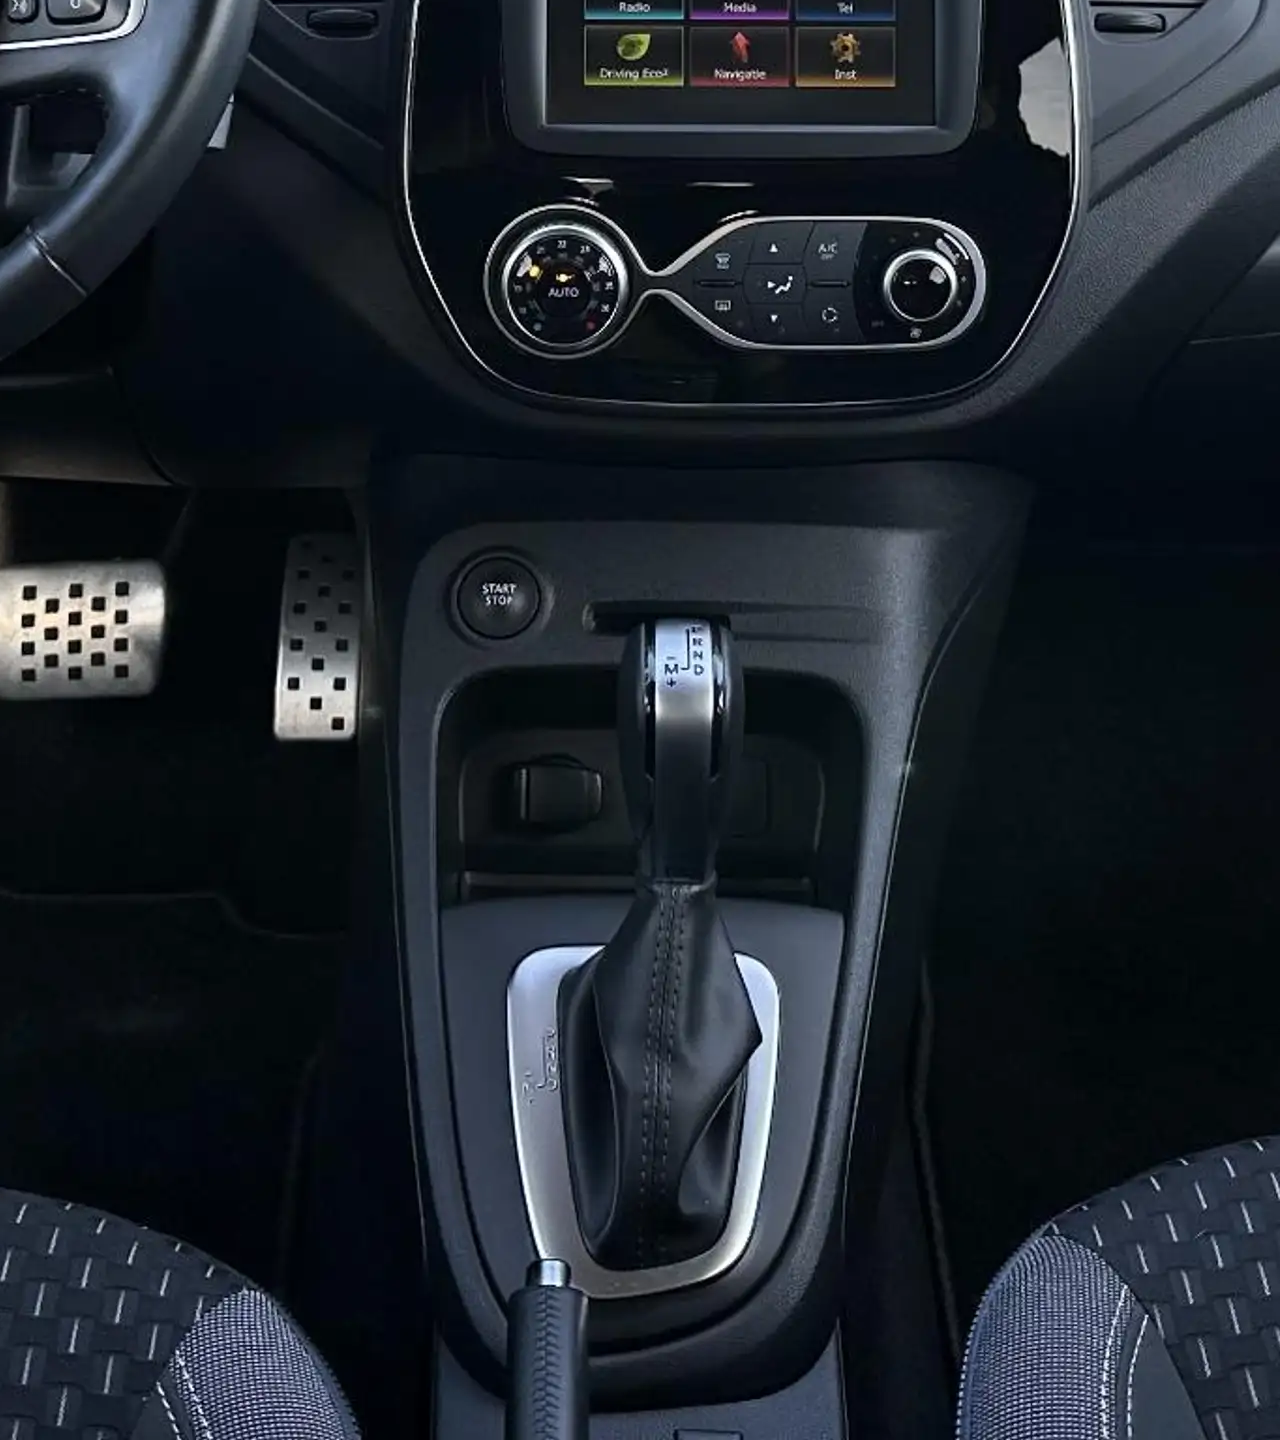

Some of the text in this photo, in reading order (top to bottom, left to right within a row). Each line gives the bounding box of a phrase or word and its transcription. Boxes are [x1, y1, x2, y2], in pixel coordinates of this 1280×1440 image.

[618, 1, 651, 13] Radio
[723, 1, 758, 14] Media
[599, 67, 640, 80] Driving
[713, 67, 768, 82] Navigatie
[817, 242, 839, 255] A/C
[547, 286, 581, 298] AUTO
[481, 582, 518, 595] START
[484, 594, 514, 606] STOP
[692, 650, 704, 661] N
[664, 663, 679, 676] M
[693, 664, 705, 677] D
